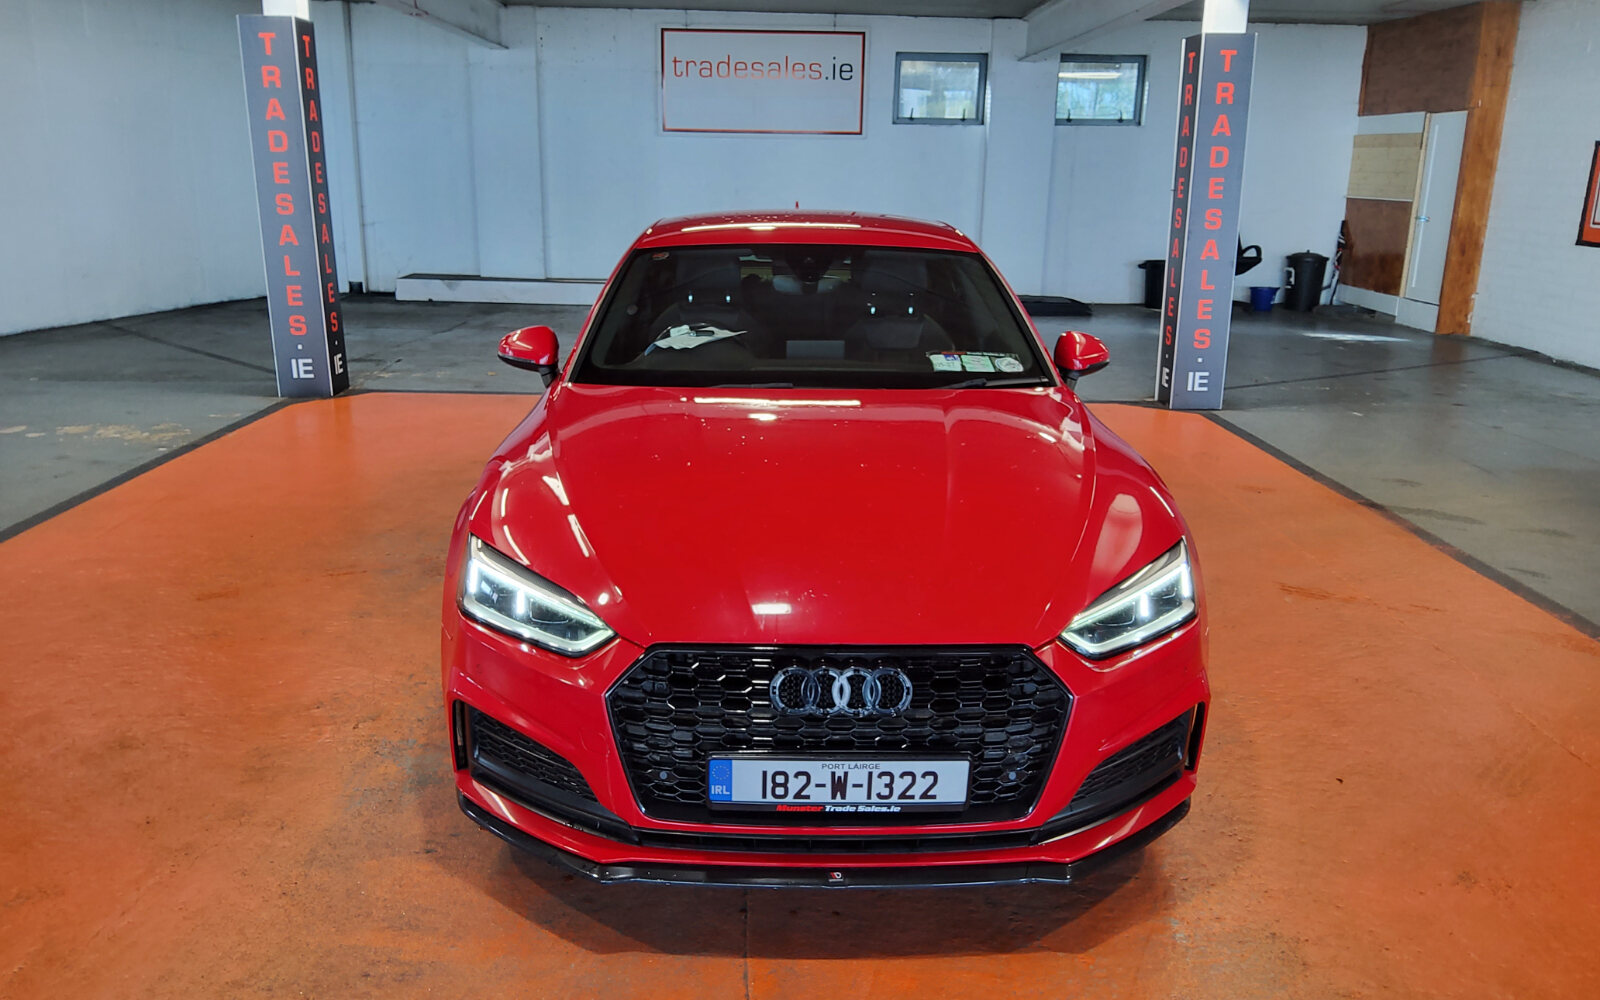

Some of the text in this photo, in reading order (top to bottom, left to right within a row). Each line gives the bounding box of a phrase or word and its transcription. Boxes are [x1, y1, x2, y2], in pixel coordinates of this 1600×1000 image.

[672, 54, 853, 81] tradesales.ie
[711, 785, 730, 795] IRL
[761, 770, 939, 800] 182-W-1322
[776, 804, 902, 812] Munster Trade Sales.ie
